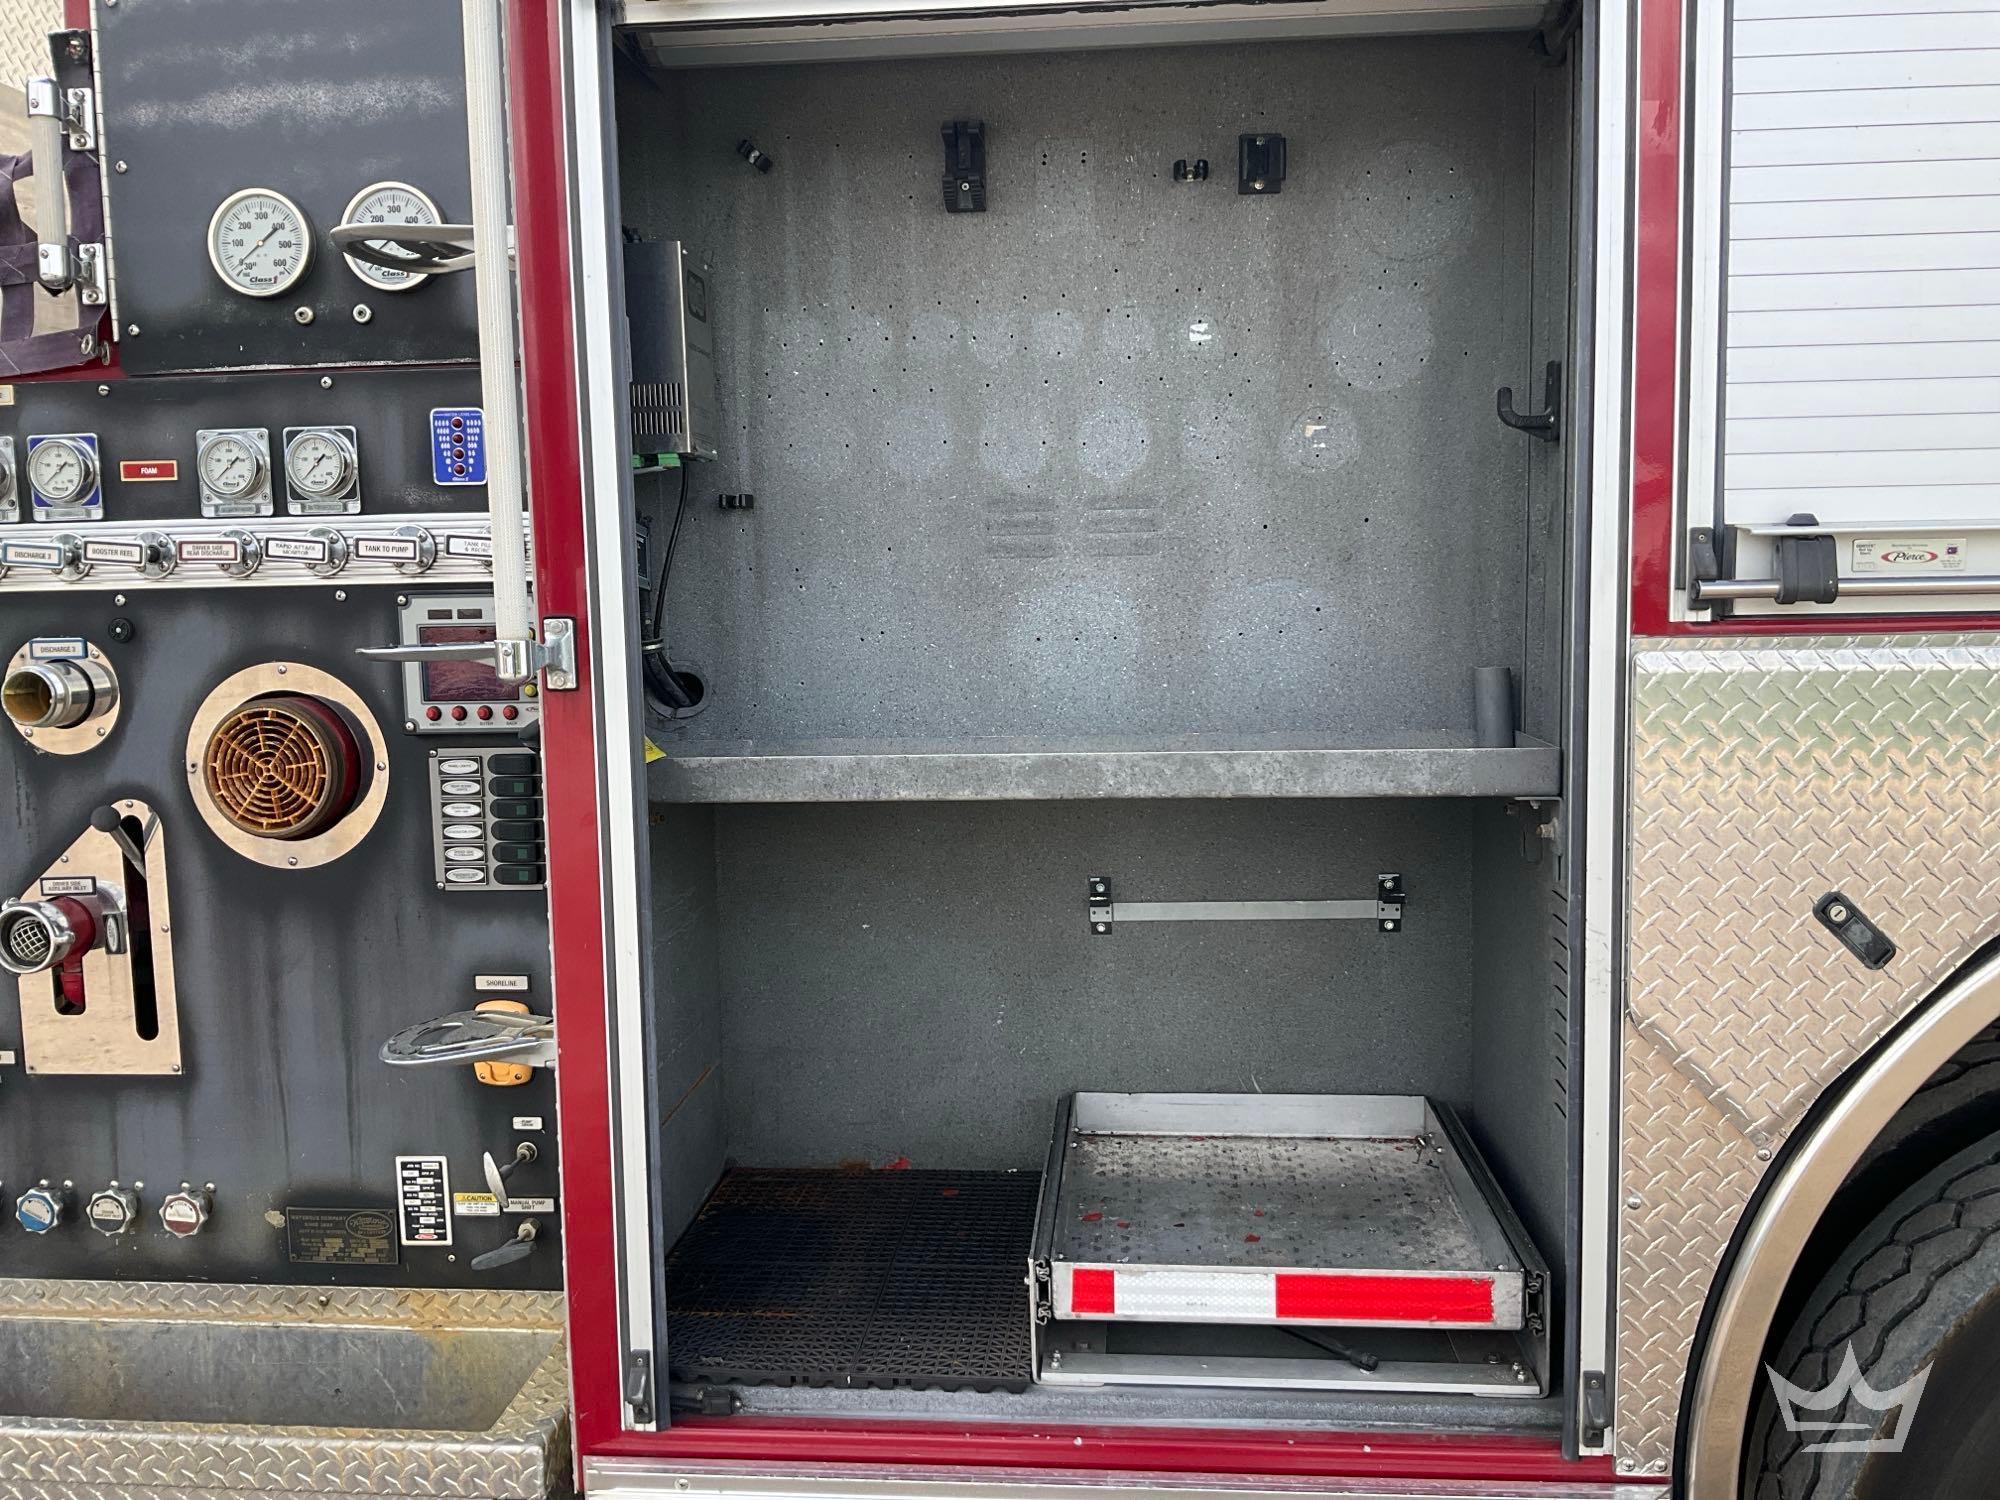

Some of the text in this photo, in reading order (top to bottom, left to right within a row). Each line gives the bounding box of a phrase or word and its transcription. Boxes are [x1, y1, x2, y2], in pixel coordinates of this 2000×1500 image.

[387, 204, 401, 213] 300
[254, 211, 268, 220] 300
[370, 214, 384, 223] 200
[404, 215, 418, 224] 400
[238, 221, 251, 230] 200
[232, 239, 243, 247] 100
[278, 240, 292, 248] 500
[273, 258, 286, 267] 600
[140, 467, 157, 475] FOAM
[14, 551, 46, 560] DISCHARGE
[1894, 552, 1925, 562] Pierce
